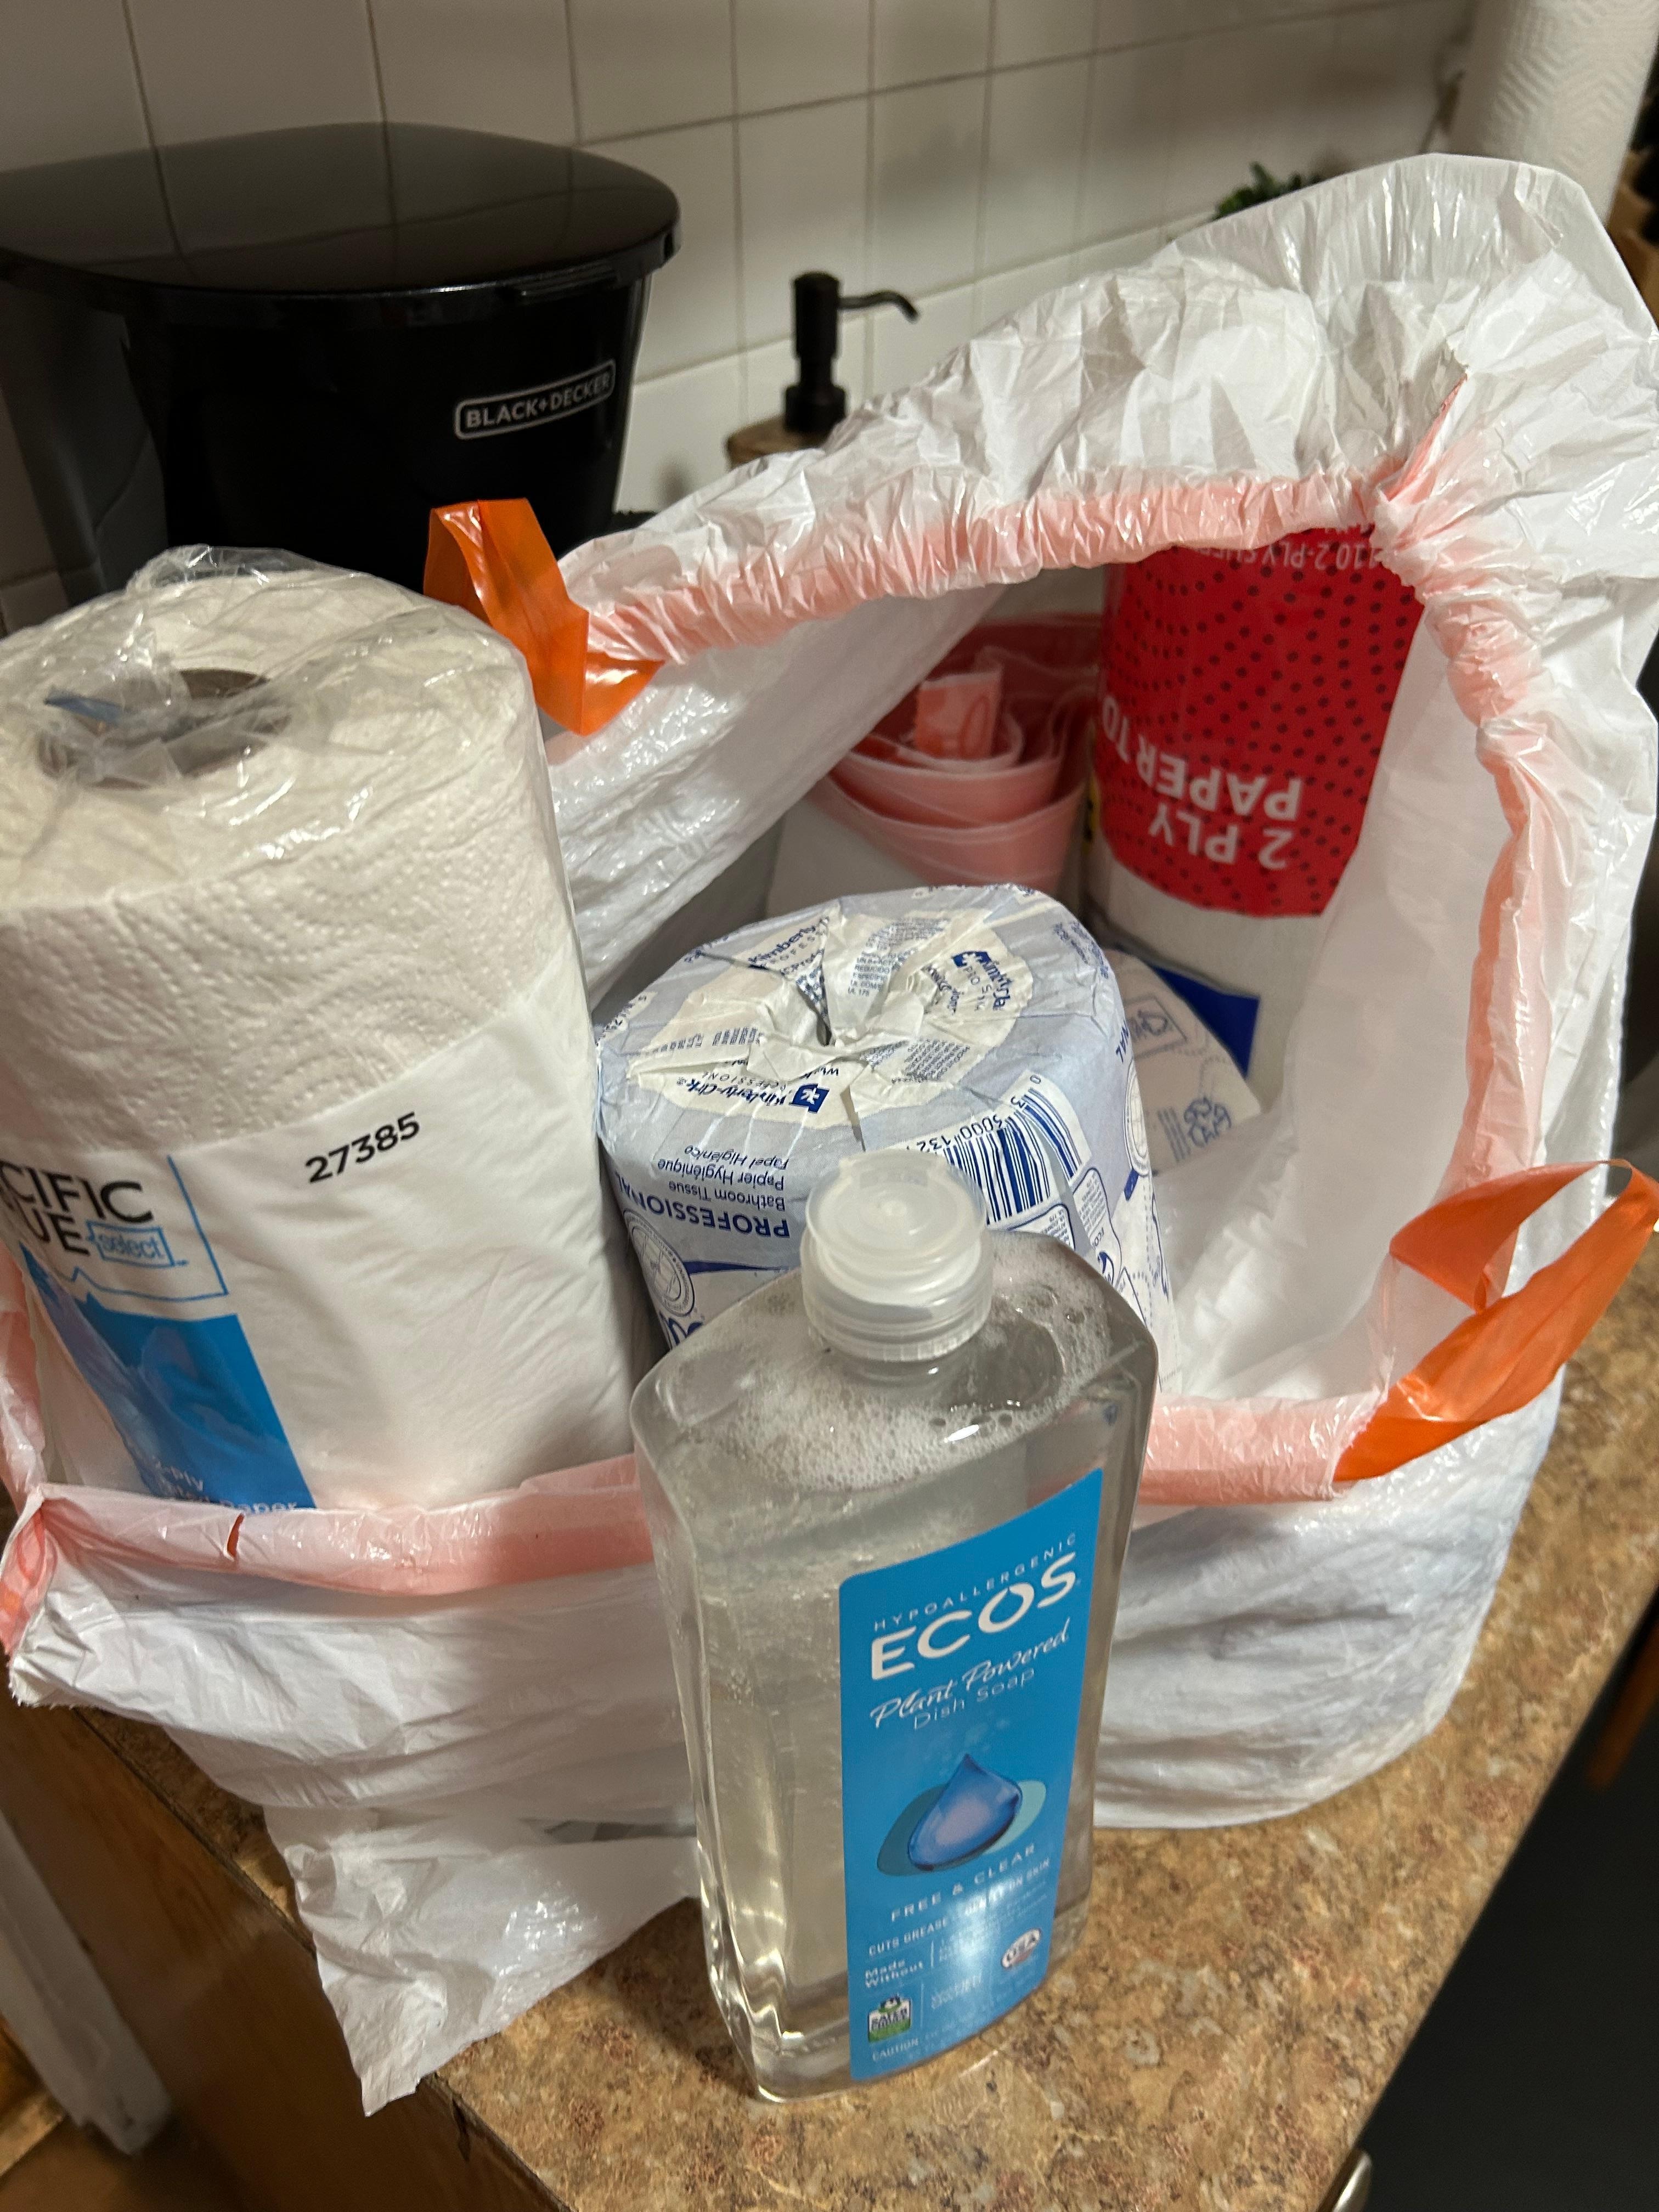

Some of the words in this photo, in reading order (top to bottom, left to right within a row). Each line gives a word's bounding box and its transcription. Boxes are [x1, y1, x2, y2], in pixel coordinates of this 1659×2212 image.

[466, 371, 610, 428] BLACK+DECKER
[1261, 540, 1331, 570] 2-PLY
[1135, 733, 1303, 820] PAPER
[1148, 801, 1240, 865] PLY
[1258, 828, 1294, 871] 2
[304, 1111, 420, 1183] 27385
[748, 1154, 790, 1171] Papel
[614, 1171, 790, 1238] PROFESSIONAL
[668, 1180, 712, 1200] Tissue
[714, 1189, 786, 1211] Bathroom
[737, 1171, 785, 1192] Papier
[98, 1233, 163, 1259] select
[874, 1532, 1076, 1632] HYPOALLERGENIC
[871, 1552, 1076, 1680] ECOS
[870, 1679, 955, 1729] Plant
[962, 1617, 1070, 1691] Powered
[914, 1698, 966, 1730] Dish
[977, 1668, 1035, 1702] Soap
[891, 1892, 941, 1922] FREE
[974, 1843, 1035, 1884] CLEAR
[865, 1959, 906, 1980] Made
[868, 1936, 900, 1956] CUTS
[865, 1960, 924, 1989] Without
